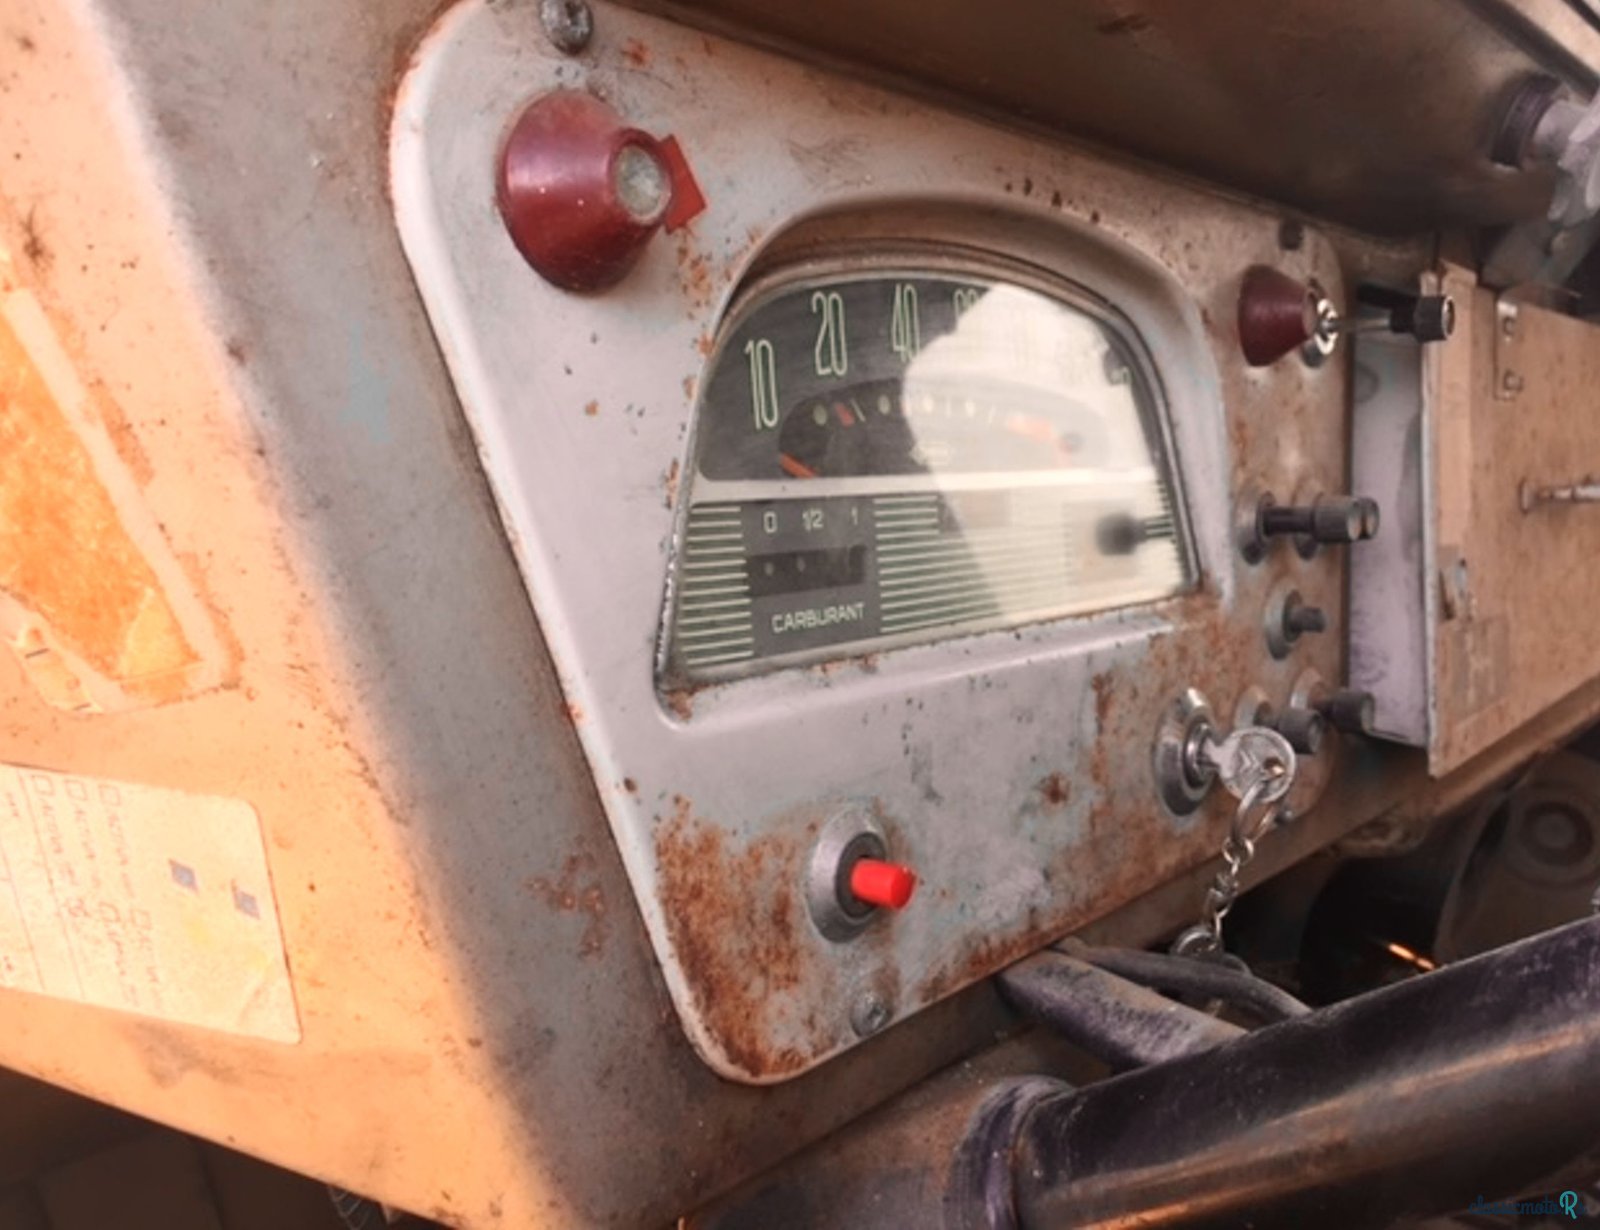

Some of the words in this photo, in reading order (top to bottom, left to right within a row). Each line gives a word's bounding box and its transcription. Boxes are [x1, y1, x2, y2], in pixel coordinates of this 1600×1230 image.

[812, 291, 848, 376] 20
[892, 283, 920, 363] 40
[744, 339, 779, 430] 10
[771, 602, 865, 634] CARBURANT
